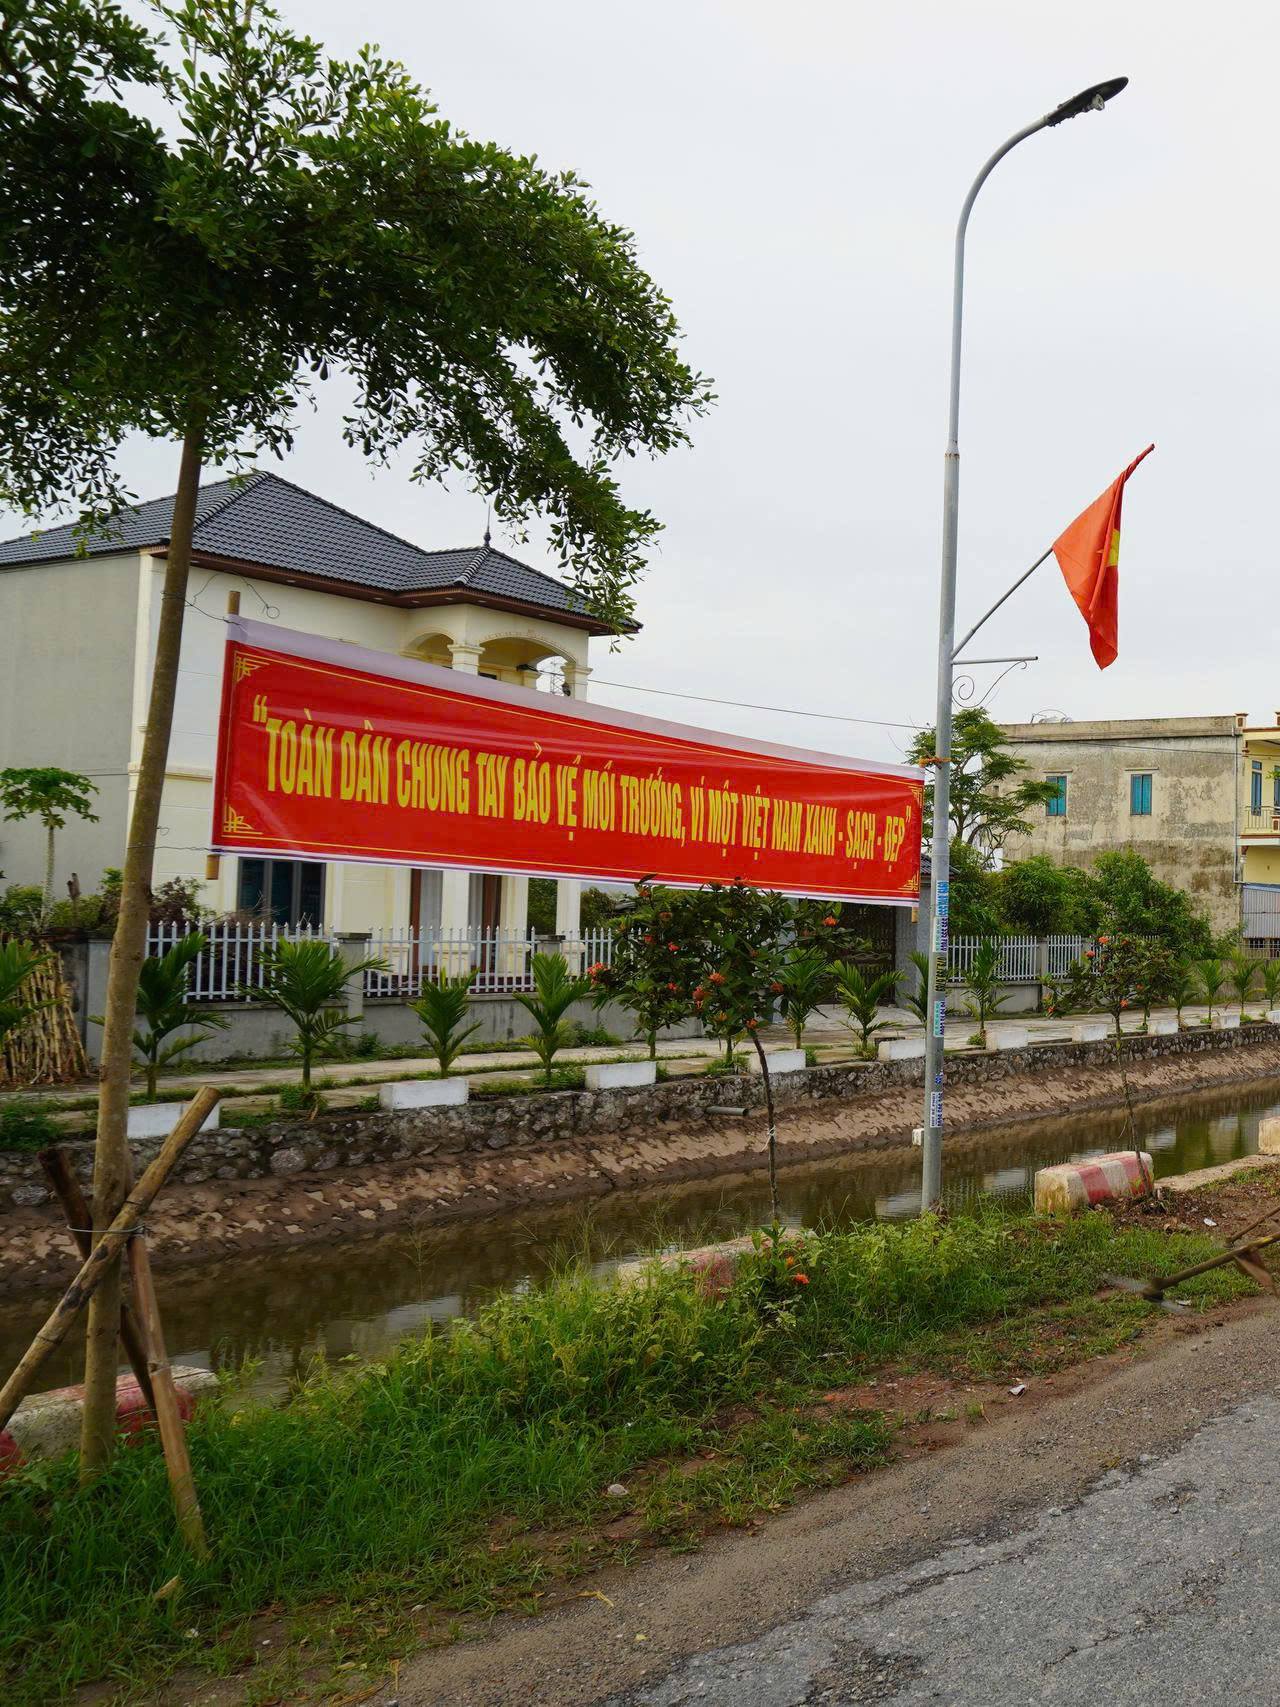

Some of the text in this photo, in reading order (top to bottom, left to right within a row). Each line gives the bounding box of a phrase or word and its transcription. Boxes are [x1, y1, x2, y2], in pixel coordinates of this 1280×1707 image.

[396, 740, 470, 815] CHUNG
[475, 752, 511, 820] TAY
[513, 741, 551, 826] BẢO
[556, 753, 581, 841] VỆ
[582, 759, 616, 832] MÔI
[708, 780, 739, 858] MỘT
[741, 785, 771, 861] VIỆT
[771, 799, 803, 853] NAM
[803, 804, 838, 856] XANH
[845, 810, 877, 870] SẠCH
